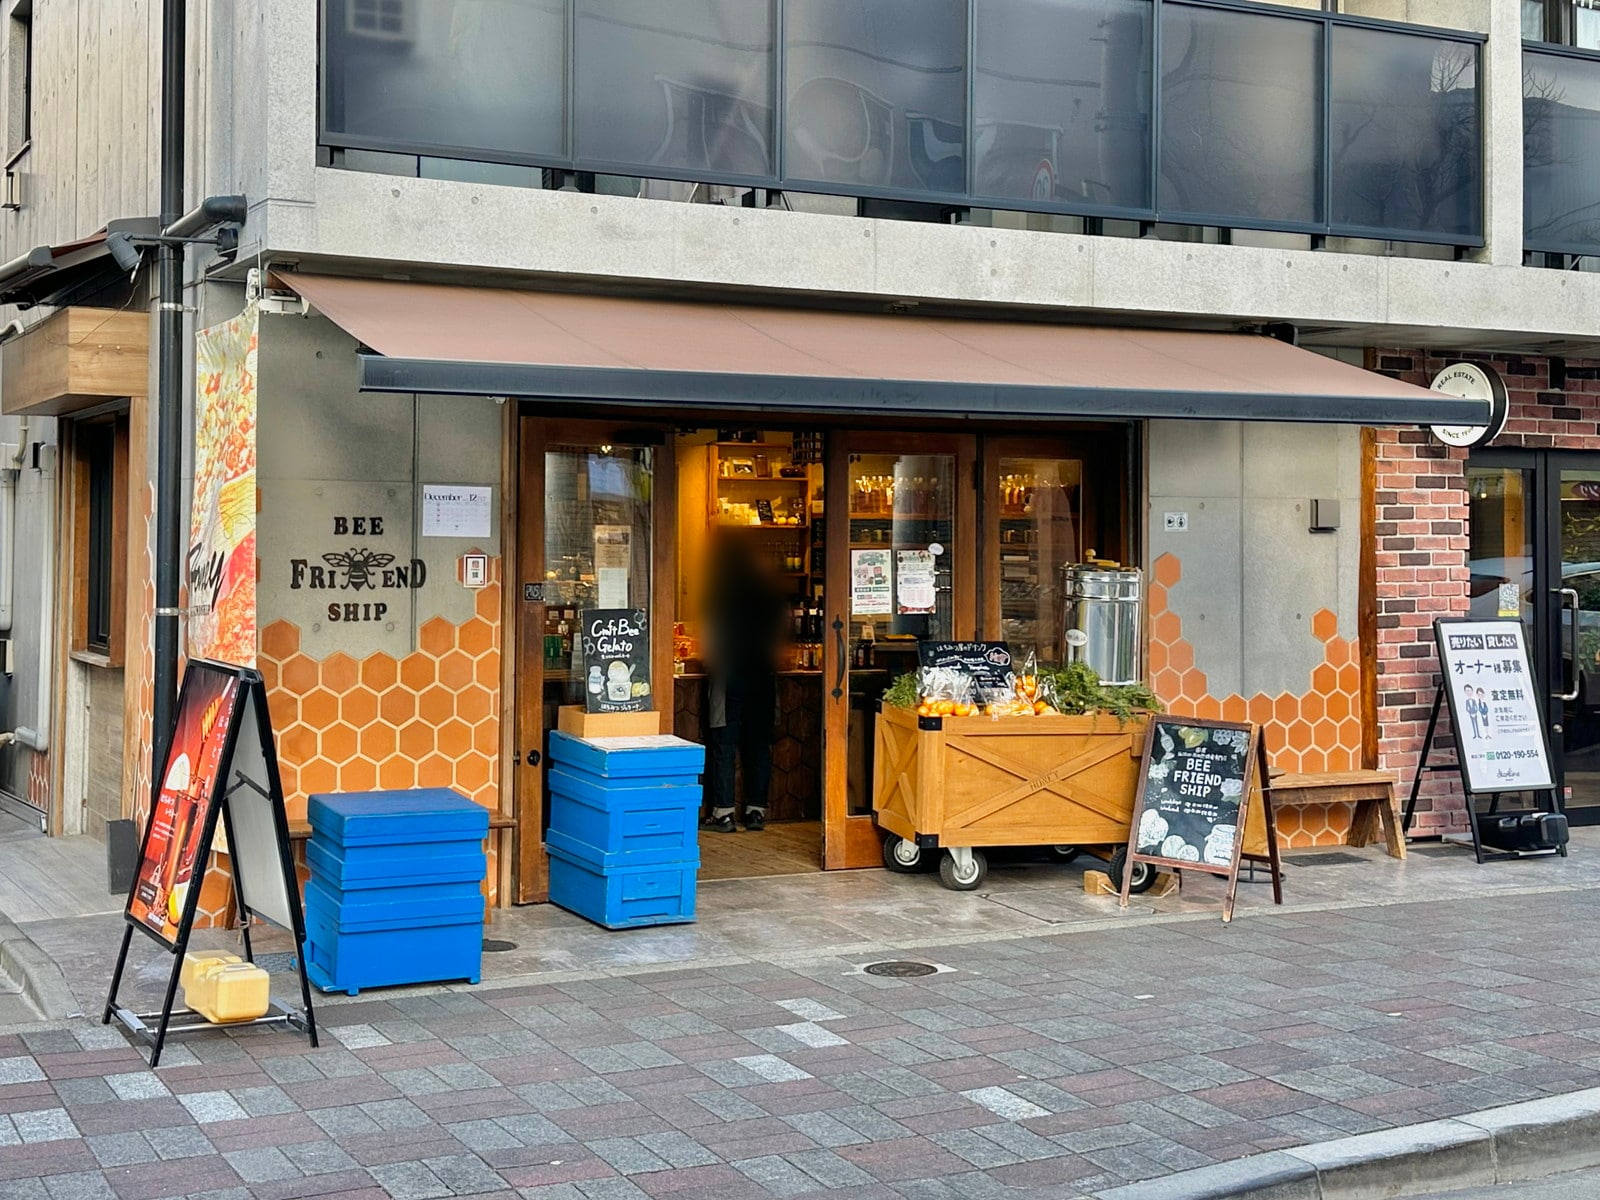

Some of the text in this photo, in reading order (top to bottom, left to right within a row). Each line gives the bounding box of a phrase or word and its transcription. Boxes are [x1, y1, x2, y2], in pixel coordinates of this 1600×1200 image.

[1437, 371, 1476, 389] REAL ESTATE
[1442, 428, 1460, 438] SINCE
[334, 516, 384, 535] BEE
[328, 603, 387, 622] SHIP
[618, 618, 640, 636] Bee
[597, 636, 633, 653] Gelato
[1451, 636, 1516, 648] 売りたい 貸したい
[1454, 659, 1522, 675] オーナー様募集
[1491, 688, 1524, 701] 査定無料
[1495, 748, 1539, 760] 0120-190-554
[1186, 758, 1211, 772] BEE
[1173, 770, 1222, 786] FRIEND
[1180, 783, 1211, 797] SHIP
